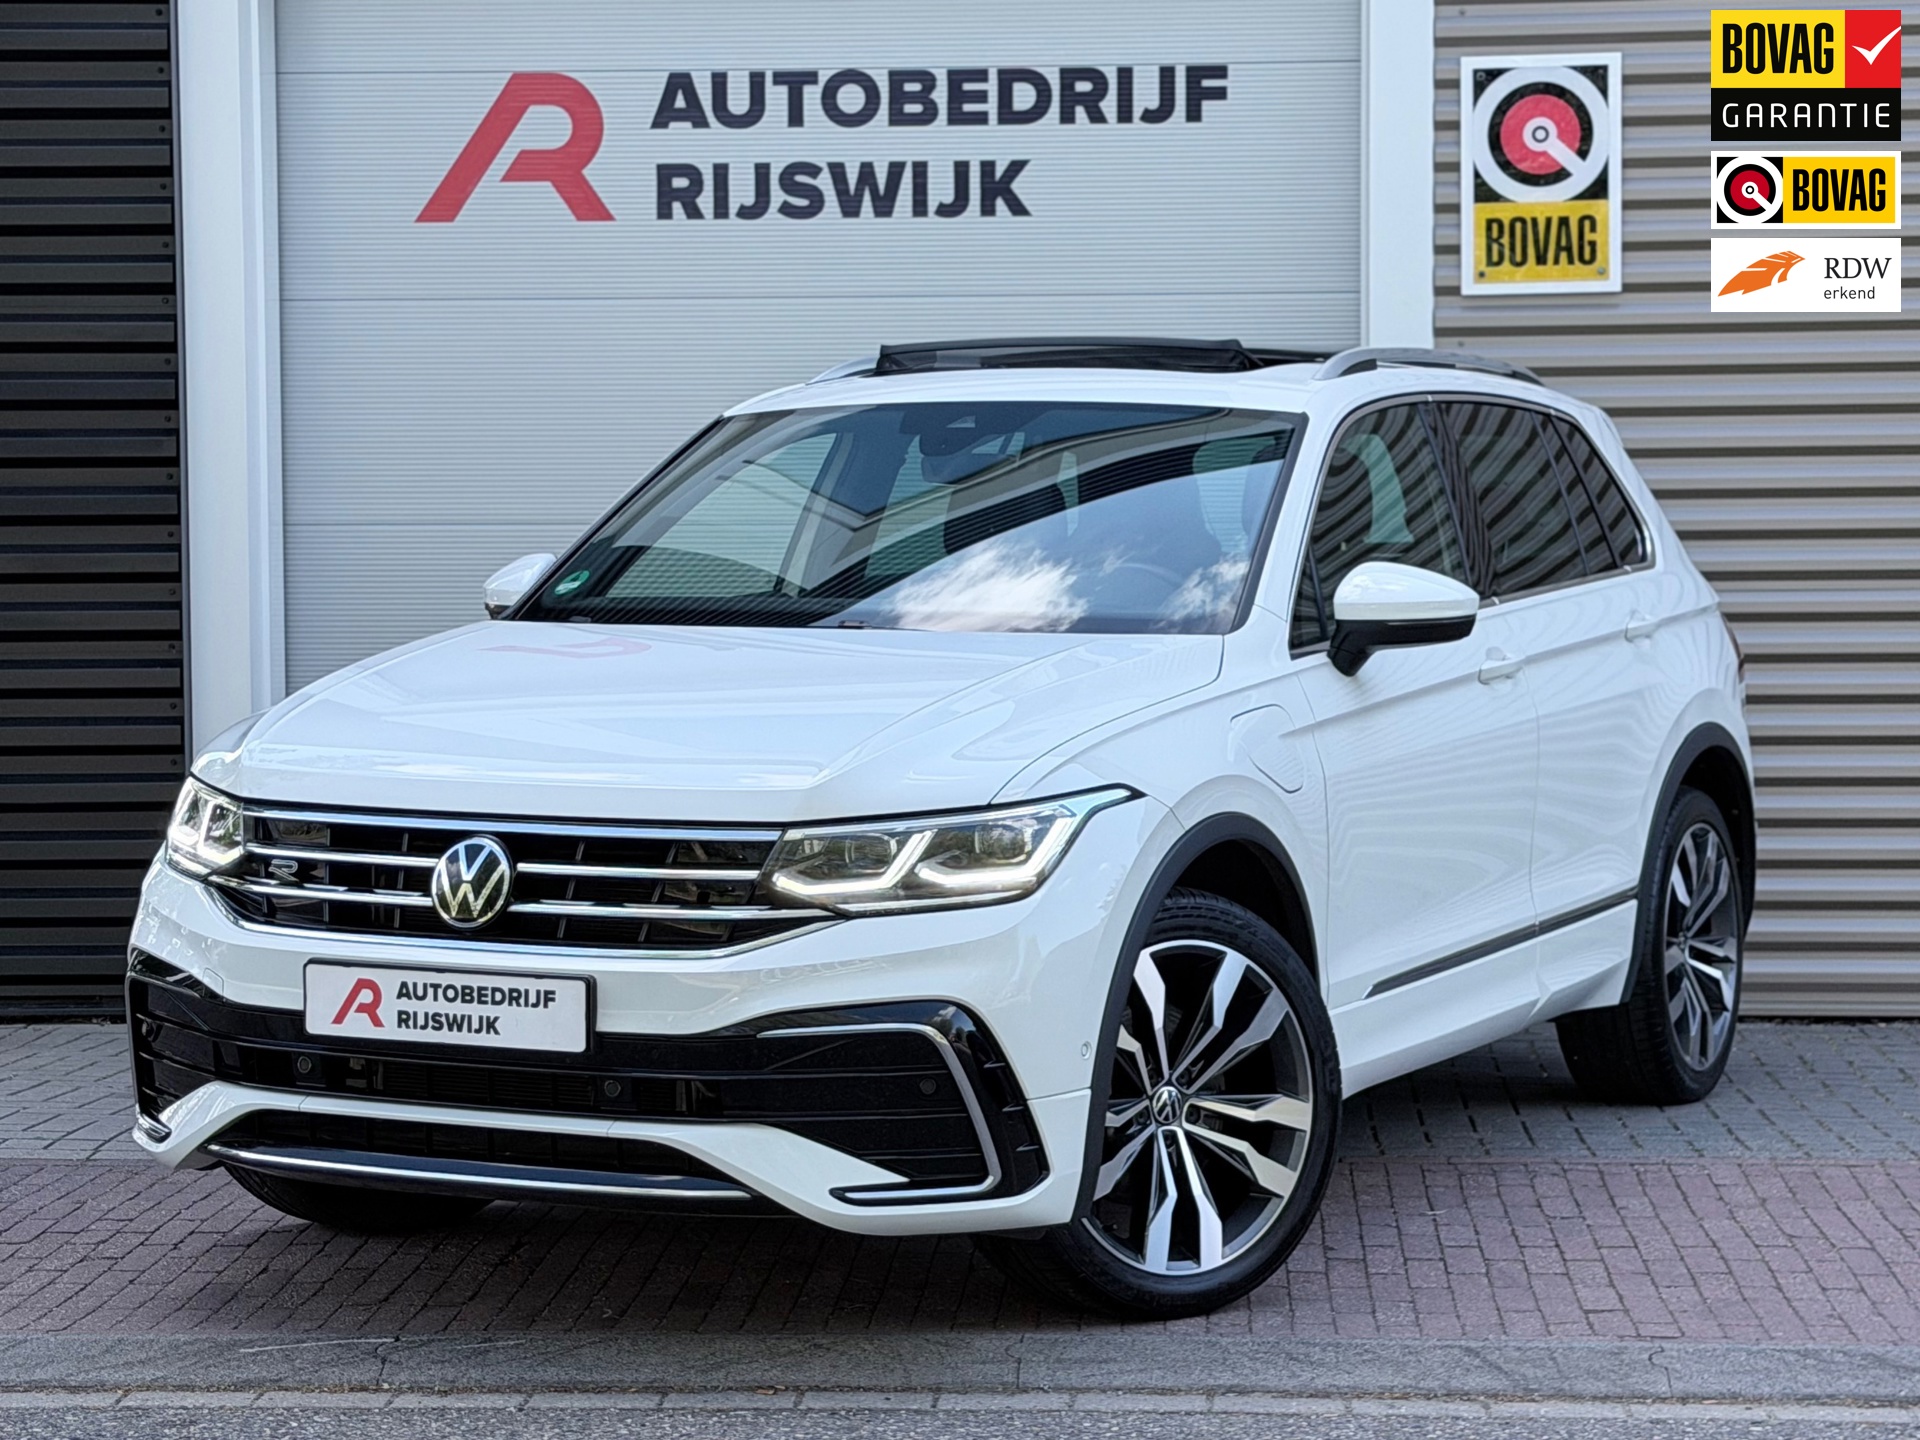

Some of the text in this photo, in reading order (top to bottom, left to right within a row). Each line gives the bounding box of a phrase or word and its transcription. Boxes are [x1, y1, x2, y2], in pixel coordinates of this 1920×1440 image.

[650, 65, 1228, 129] AUTOBEDRIJF
[655, 159, 1031, 221] RIJSWIJK
[1485, 214, 1597, 268] BOVAG
[396, 981, 556, 1009] AUTOBEDRIJF
[397, 1010, 501, 1036] RIJSWIJK
